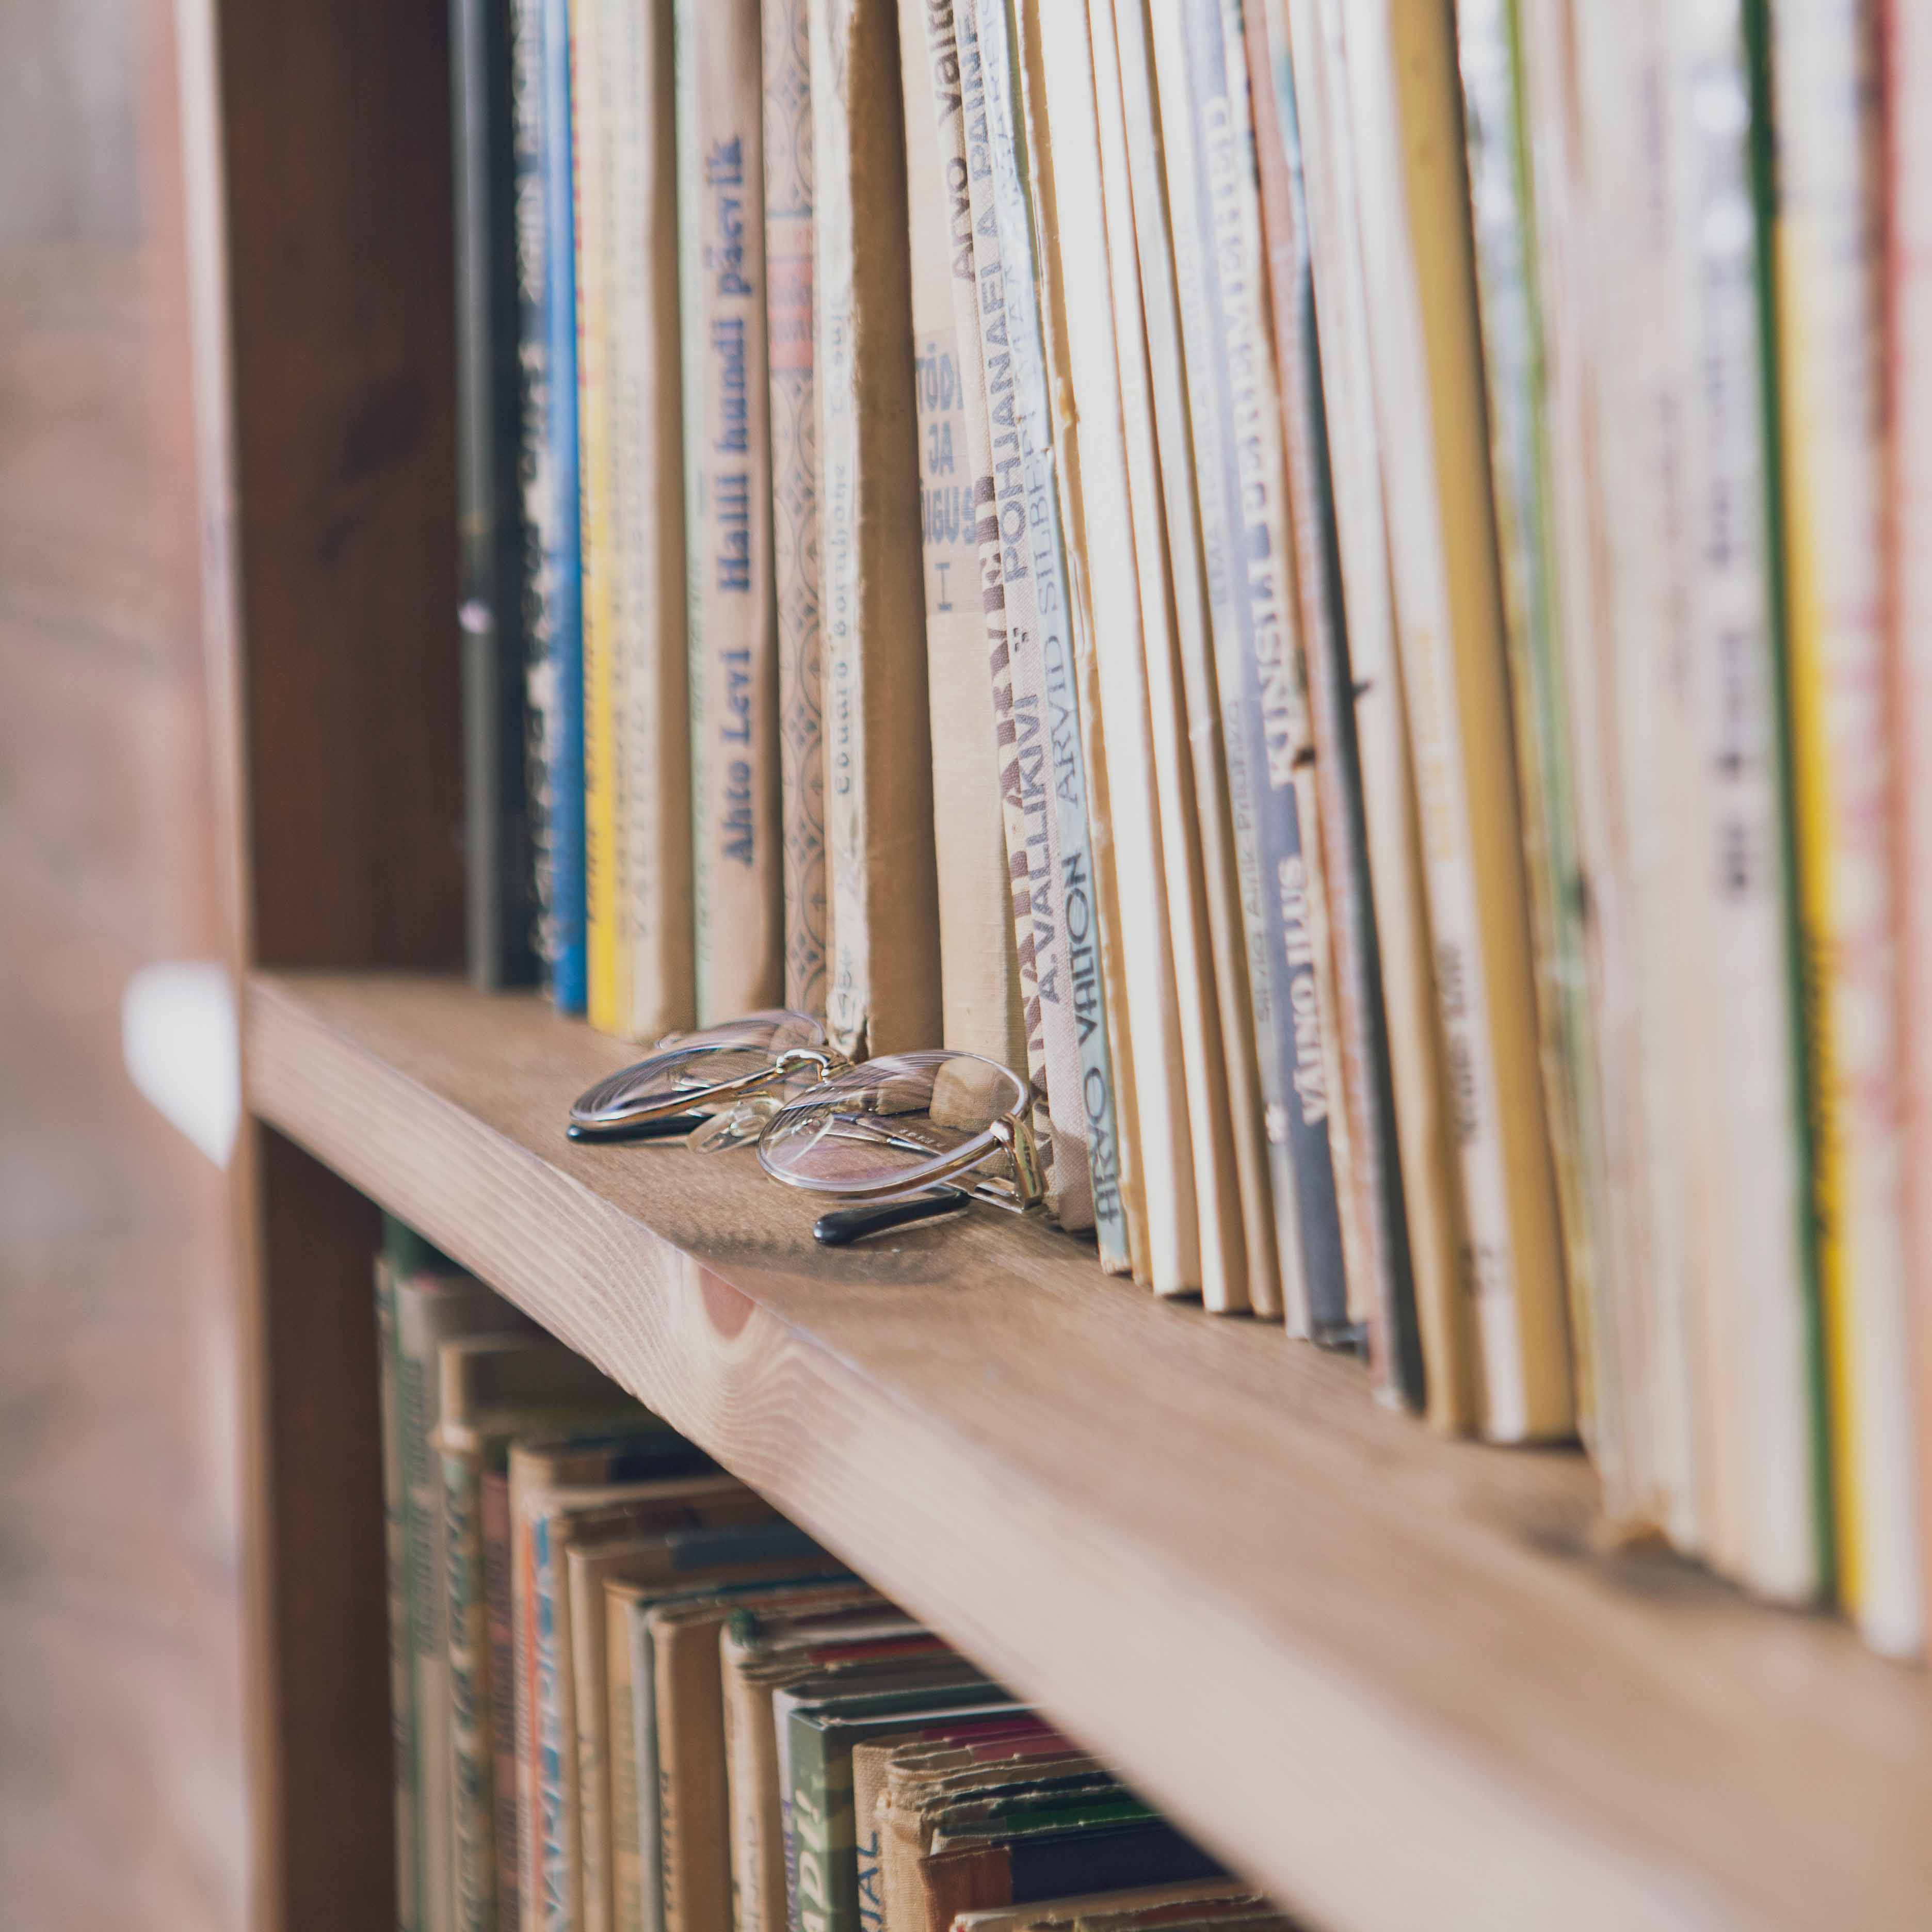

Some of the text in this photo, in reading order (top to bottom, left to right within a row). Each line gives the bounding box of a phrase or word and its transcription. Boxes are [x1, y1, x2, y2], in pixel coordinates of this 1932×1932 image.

[945, 156, 975, 282] Arvo
[702, 133, 755, 868] Ahto Levi Halli hundi päevik
[928, 421, 955, 477] JA
[1043, 635, 1077, 805] ARVID
[1060, 853, 1098, 1048] VALTON
[1278, 855, 1312, 968] ILUS
[1289, 973, 1327, 1125] VÄINO
[1084, 1066, 1119, 1225] ARVO
